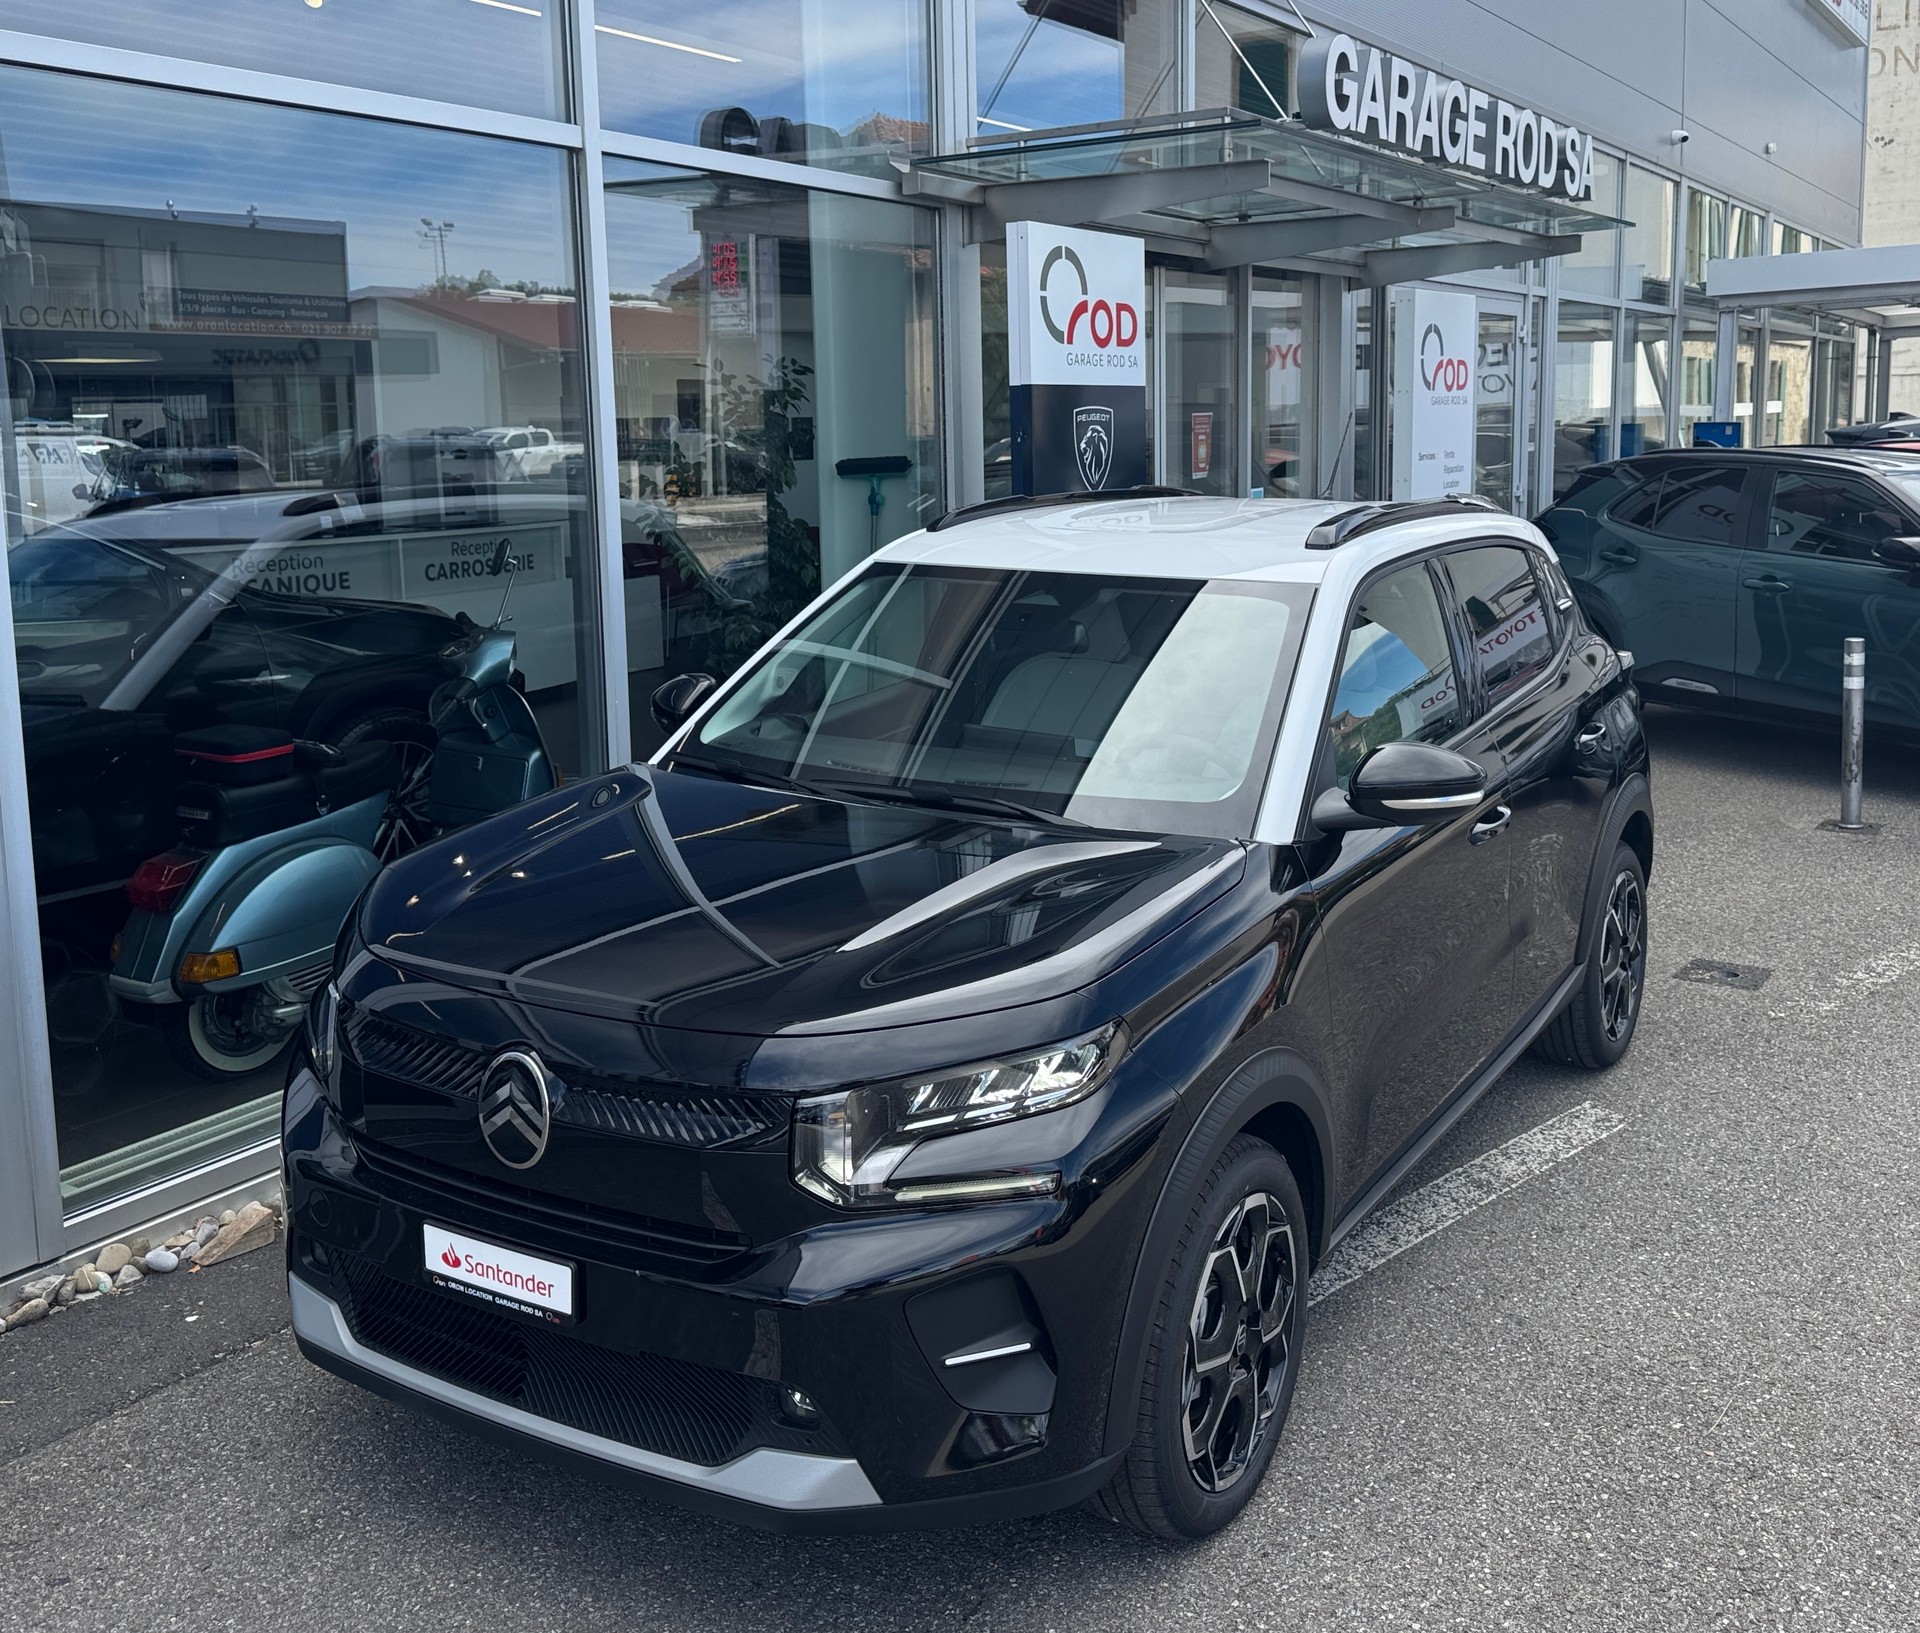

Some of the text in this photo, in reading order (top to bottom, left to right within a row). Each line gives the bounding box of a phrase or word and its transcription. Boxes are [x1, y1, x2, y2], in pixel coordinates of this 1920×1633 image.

[1324, 33, 1594, 200] GARAGE ROD SA
[177, 290, 197, 300] Tous
[198, 292, 220, 303] types
[221, 292, 231, 301] de
[5, 304, 140, 331] LOCATION
[201, 304, 227, 315] places
[231, 305, 247, 315] Bus
[251, 307, 286, 318] Camping
[290, 308, 329, 319] Remorque
[1066, 352, 1139, 369] GARAGE ROD SA
[1431, 395, 1468, 406] GARAGE ROD SA
[1077, 413, 1111, 423] PEUGEOT
[451, 540, 506, 558] Récepti
[231, 553, 324, 576] Réception
[424, 553, 535, 582] CARROSERIE
[464, 1254, 555, 1298] Santander
[447, 1281, 464, 1292] ORON
[465, 1286, 493, 1302] LOCATION
[494, 1296, 520, 1310] GARAGE
[520, 1304, 534, 1315] ROD
[534, 1309, 543, 1318] SA
